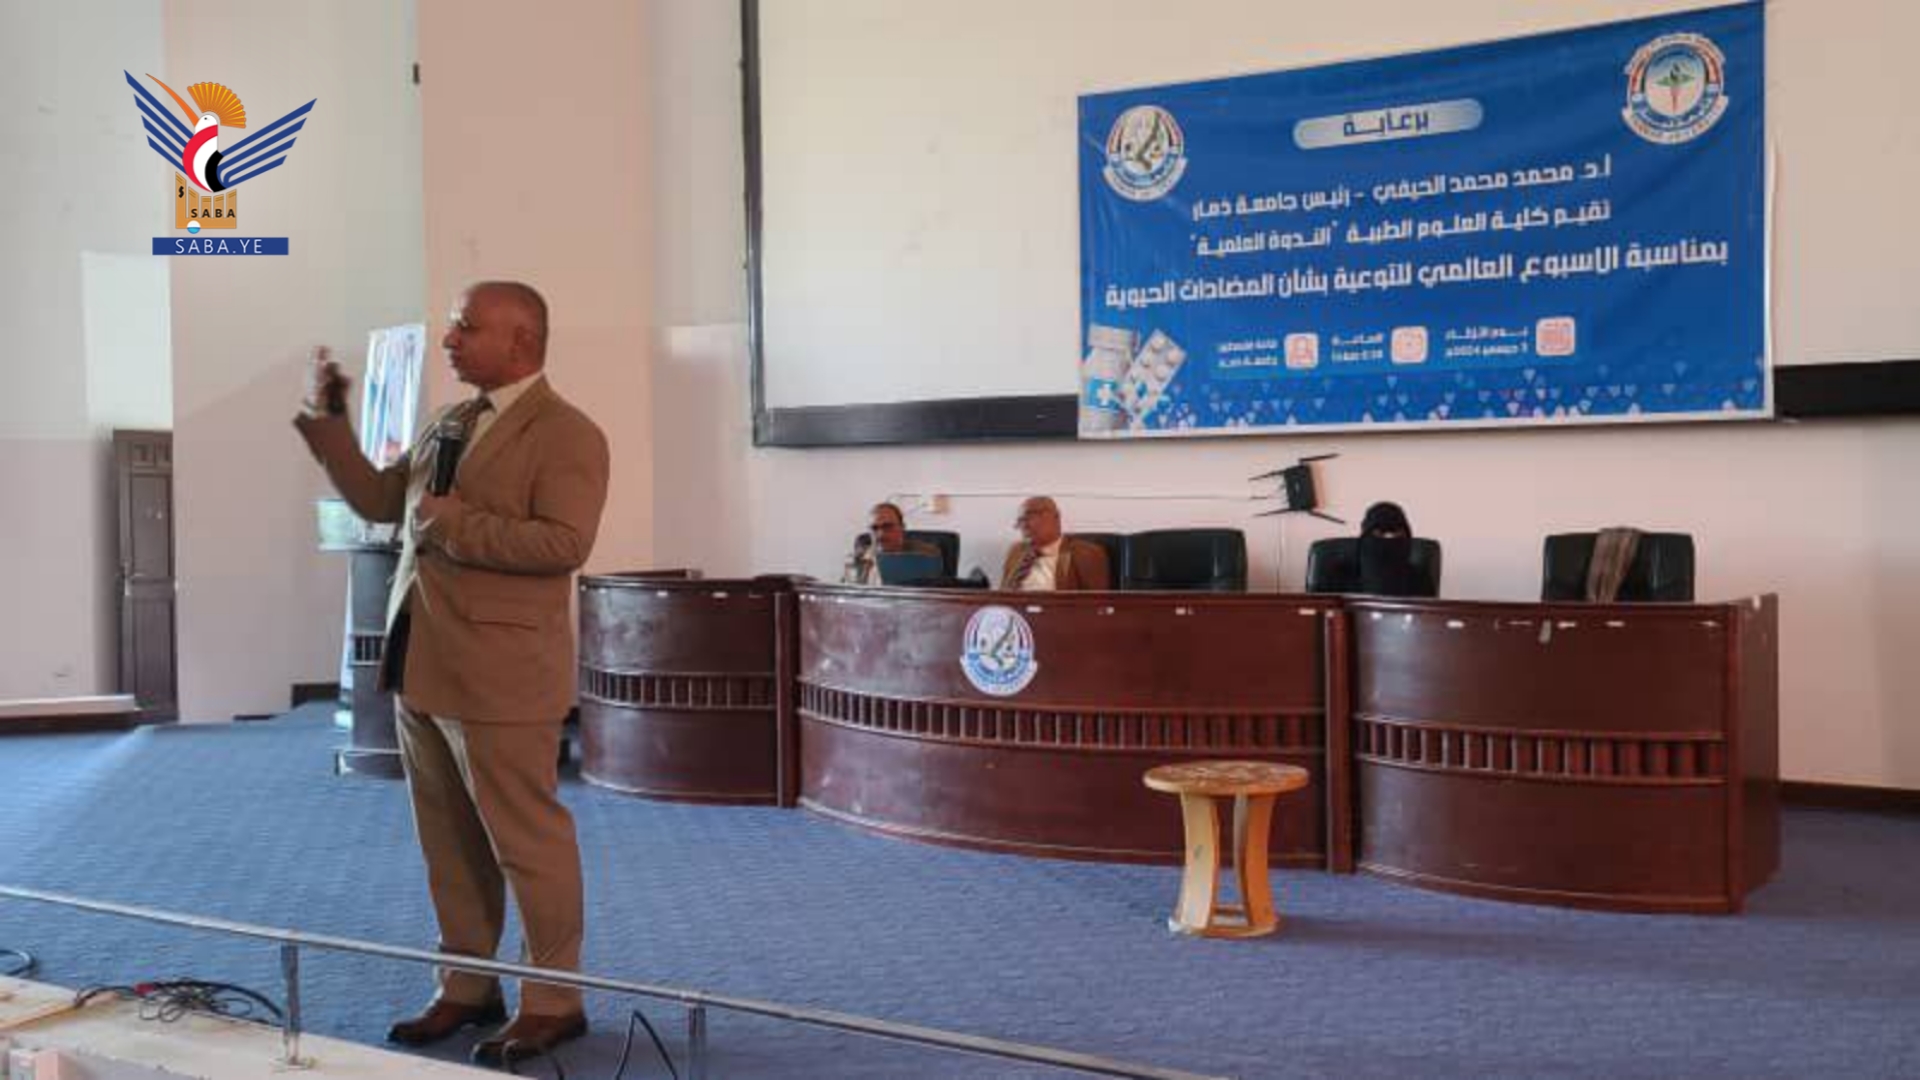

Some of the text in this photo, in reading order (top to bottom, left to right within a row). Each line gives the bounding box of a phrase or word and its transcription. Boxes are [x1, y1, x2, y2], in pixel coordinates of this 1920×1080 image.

[1450, 172, 1508, 194] محمد
[1513, 164, 1573, 187] محمد
[1236, 192, 1298, 215] جامعة
[1346, 218, 1412, 244] الطبية
[1417, 212, 1487, 241] العلوم
[1491, 207, 1549, 231] كلية
[1625, 237, 1729, 270] بمناسبة
[1334, 262, 1412, 294] للتوعية
[1417, 253, 1513, 289] العالمي
[1105, 280, 1176, 310] الحيوية
[1179, 273, 1275, 300] المضادات
